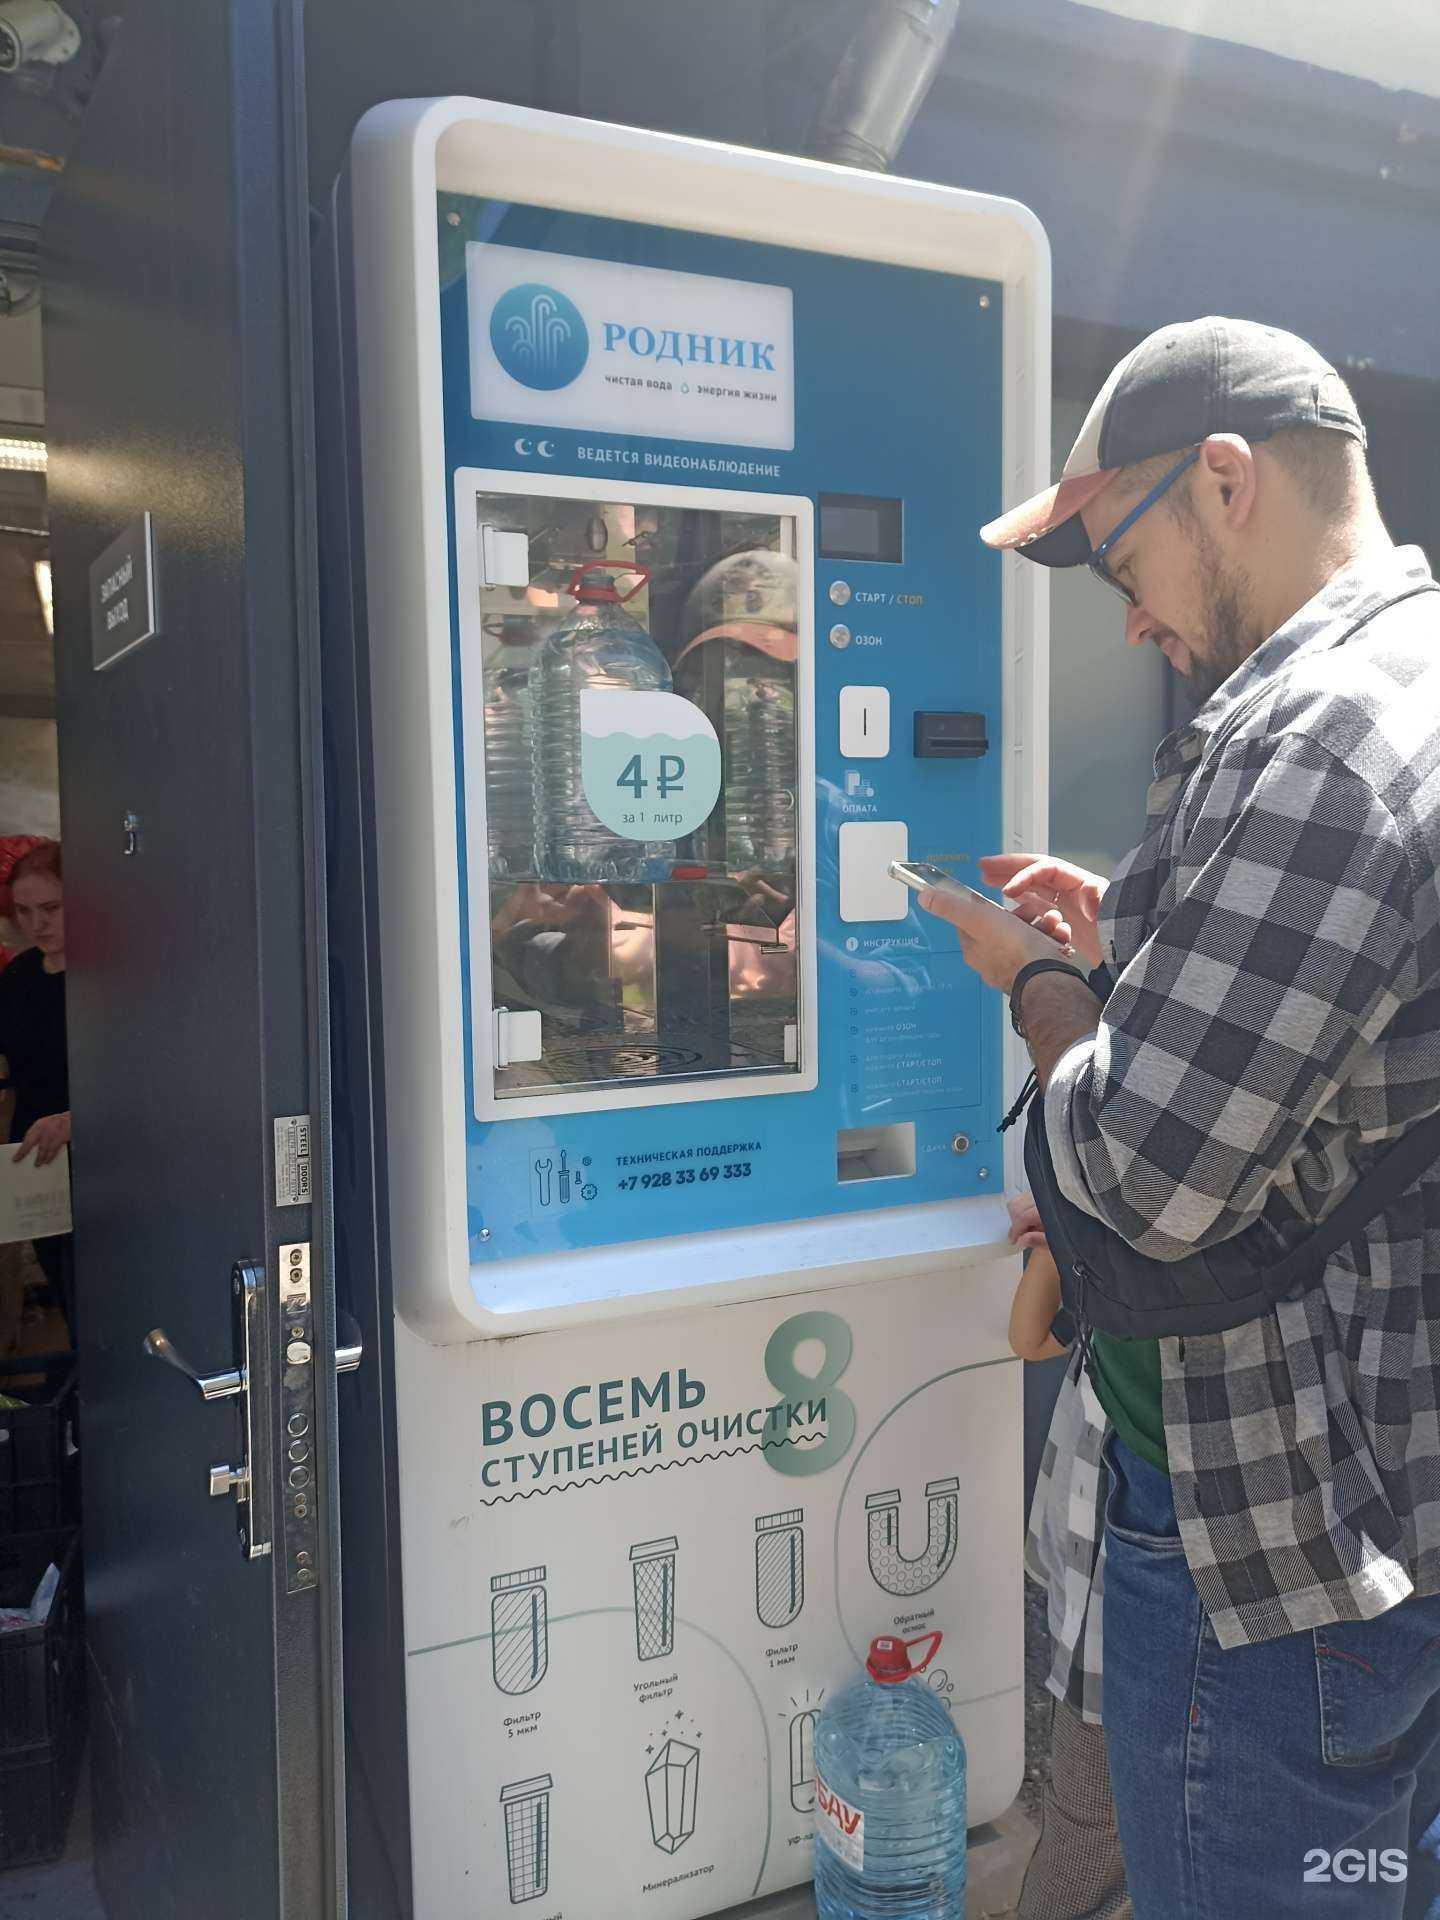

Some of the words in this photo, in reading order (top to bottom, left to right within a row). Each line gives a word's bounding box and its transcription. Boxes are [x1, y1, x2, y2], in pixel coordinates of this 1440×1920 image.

[602, 322, 776, 371] РОДНИК
[604, 374, 644, 387] чистая
[646, 380, 673, 391] вода
[697, 385, 740, 398] энергия
[743, 389, 778, 401] жизни
[577, 446, 639, 465] ВЕДЕТСЯ
[644, 453, 780, 478] ВИДЕОНАБЛЮДЕНИЕ
[855, 591, 886, 604] СТАРТ
[896, 594, 923, 605] СТОП
[855, 635, 883, 646] ОЗОН
[622, 814, 635, 823] за
[640, 812, 644, 822] 1
[653, 813, 683, 826] литр
[842, 803, 877, 814] ОПЛАТА
[863, 936, 920, 948] ИНСТРУКЦИЯ
[616, 1150, 693, 1167] ТЕХНИЧЕСКАЯ
[697, 1141, 762, 1157] ПОДДЕРЖКА
[618, 1175, 637, 1191] +7
[642, 1171, 672, 1188] 928
[676, 1169, 695, 1185] 33
[699, 1166, 719, 1182] 69
[723, 1162, 751, 1179] 333
[761, 1311, 856, 1477] 8
[482, 1368, 706, 1446] ВОСЕМЬ
[481, 1422, 662, 1487] СТУПЕНЕЙ
[677, 1398, 826, 1449] ОЧИСТКИ
[765, 1643, 799, 1658] Фильтр
[633, 1673, 679, 1692] Угольный
[503, 1711, 541, 1727] Фильтр
[507, 1729, 514, 1738] 5
[517, 1725, 538, 1736] мкм
[642, 1863, 715, 1893] Минерализатор
